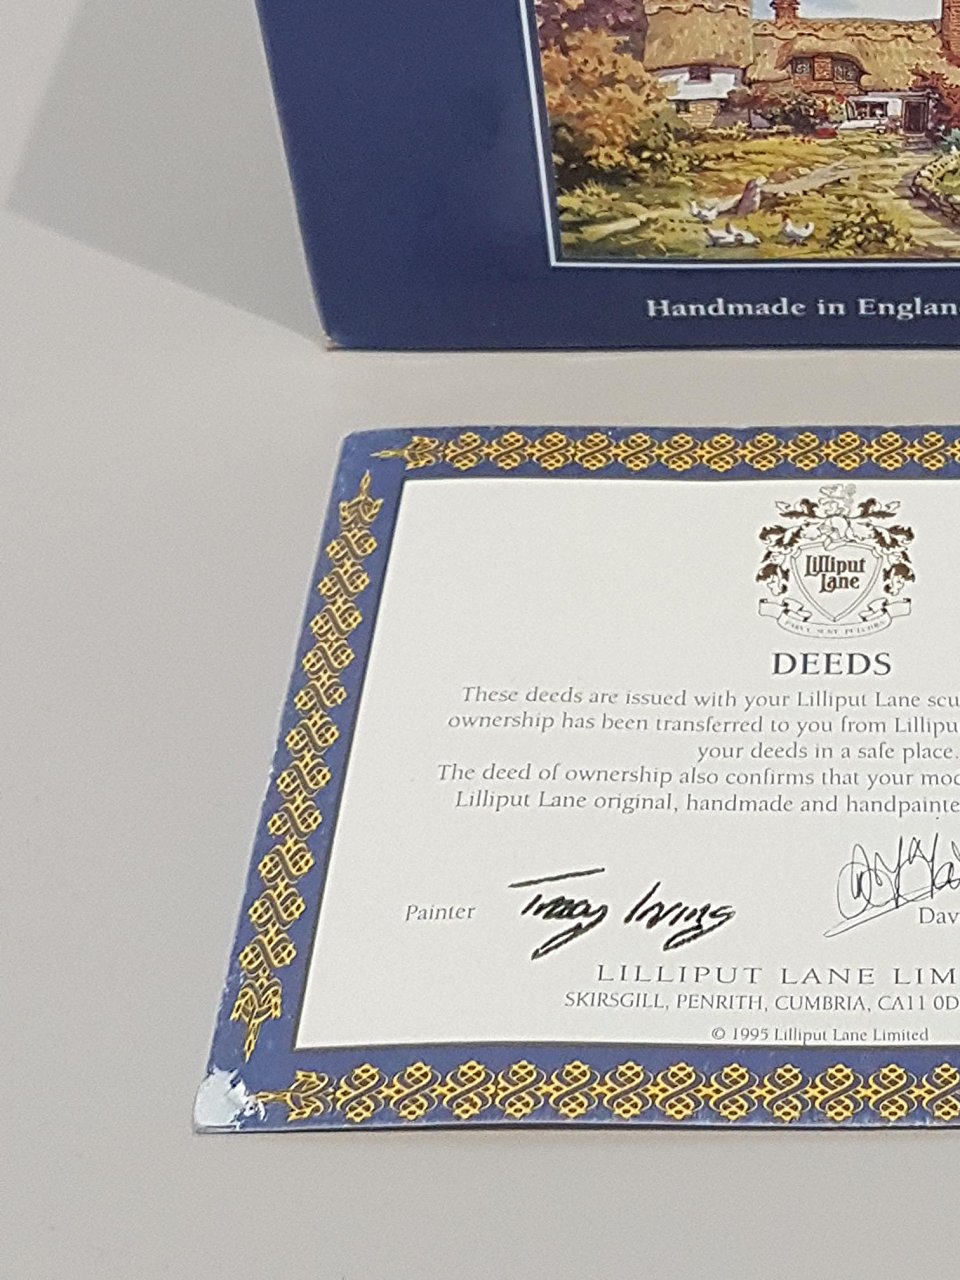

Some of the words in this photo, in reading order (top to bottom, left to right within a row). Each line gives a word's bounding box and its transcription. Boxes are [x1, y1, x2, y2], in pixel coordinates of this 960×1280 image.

[646, 297, 807, 318] Handmade
[816, 297, 846, 317] in
[804, 554, 867, 577] Lilliput
[818, 574, 860, 594] Lane
[771, 652, 892, 676] DEEDS
[461, 686, 519, 704] These
[525, 687, 583, 704] deeds
[588, 690, 619, 705] are
[625, 690, 687, 706] issued
[693, 690, 737, 708] with
[743, 692, 791, 712] your
[797, 690, 867, 711] Lilliput
[874, 690, 921, 708] Lane
[447, 711, 556, 733] ownership
[561, 712, 596, 730] has
[601, 712, 648, 731] been
[655, 714, 764, 733] transferred
[770, 717, 790, 733] to
[796, 718, 834, 737] you
[840, 716, 887, 733] from
[696, 743, 745, 763] your
[750, 741, 809, 760] deeds
[814, 742, 834, 760] in
[857, 742, 896, 760] safe
[902, 743, 960, 764] place.
[437, 763, 476, 782] The
[481, 763, 532, 782] deed
[538, 763, 562, 783] of
[564, 766, 673, 788] ownership
[678, 767, 719, 785] also
[724, 767, 815, 786] confirms
[821, 768, 860, 786] that
[866, 770, 914, 790] your
[454, 789, 531, 812] Lilliput
[538, 790, 588, 809] Lane
[593, 792, 679, 814] original,
[685, 793, 794, 813] handmade
[800, 794, 838, 813] and
[405, 903, 476, 923] Painter
[597, 964, 763, 985] LILLIPUT
[781, 967, 875, 986] LANE
[563, 991, 670, 1011] SKIRSGILL,
[676, 993, 769, 1013] PENRITH,
[774, 995, 872, 1012] CUMBRIA,
[877, 995, 925, 1011] CA11
[732, 1027, 769, 1042] 1995
[773, 1028, 827, 1046] Lilliput
[832, 1027, 868, 1042] Lane
[872, 1027, 929, 1042] Limited
